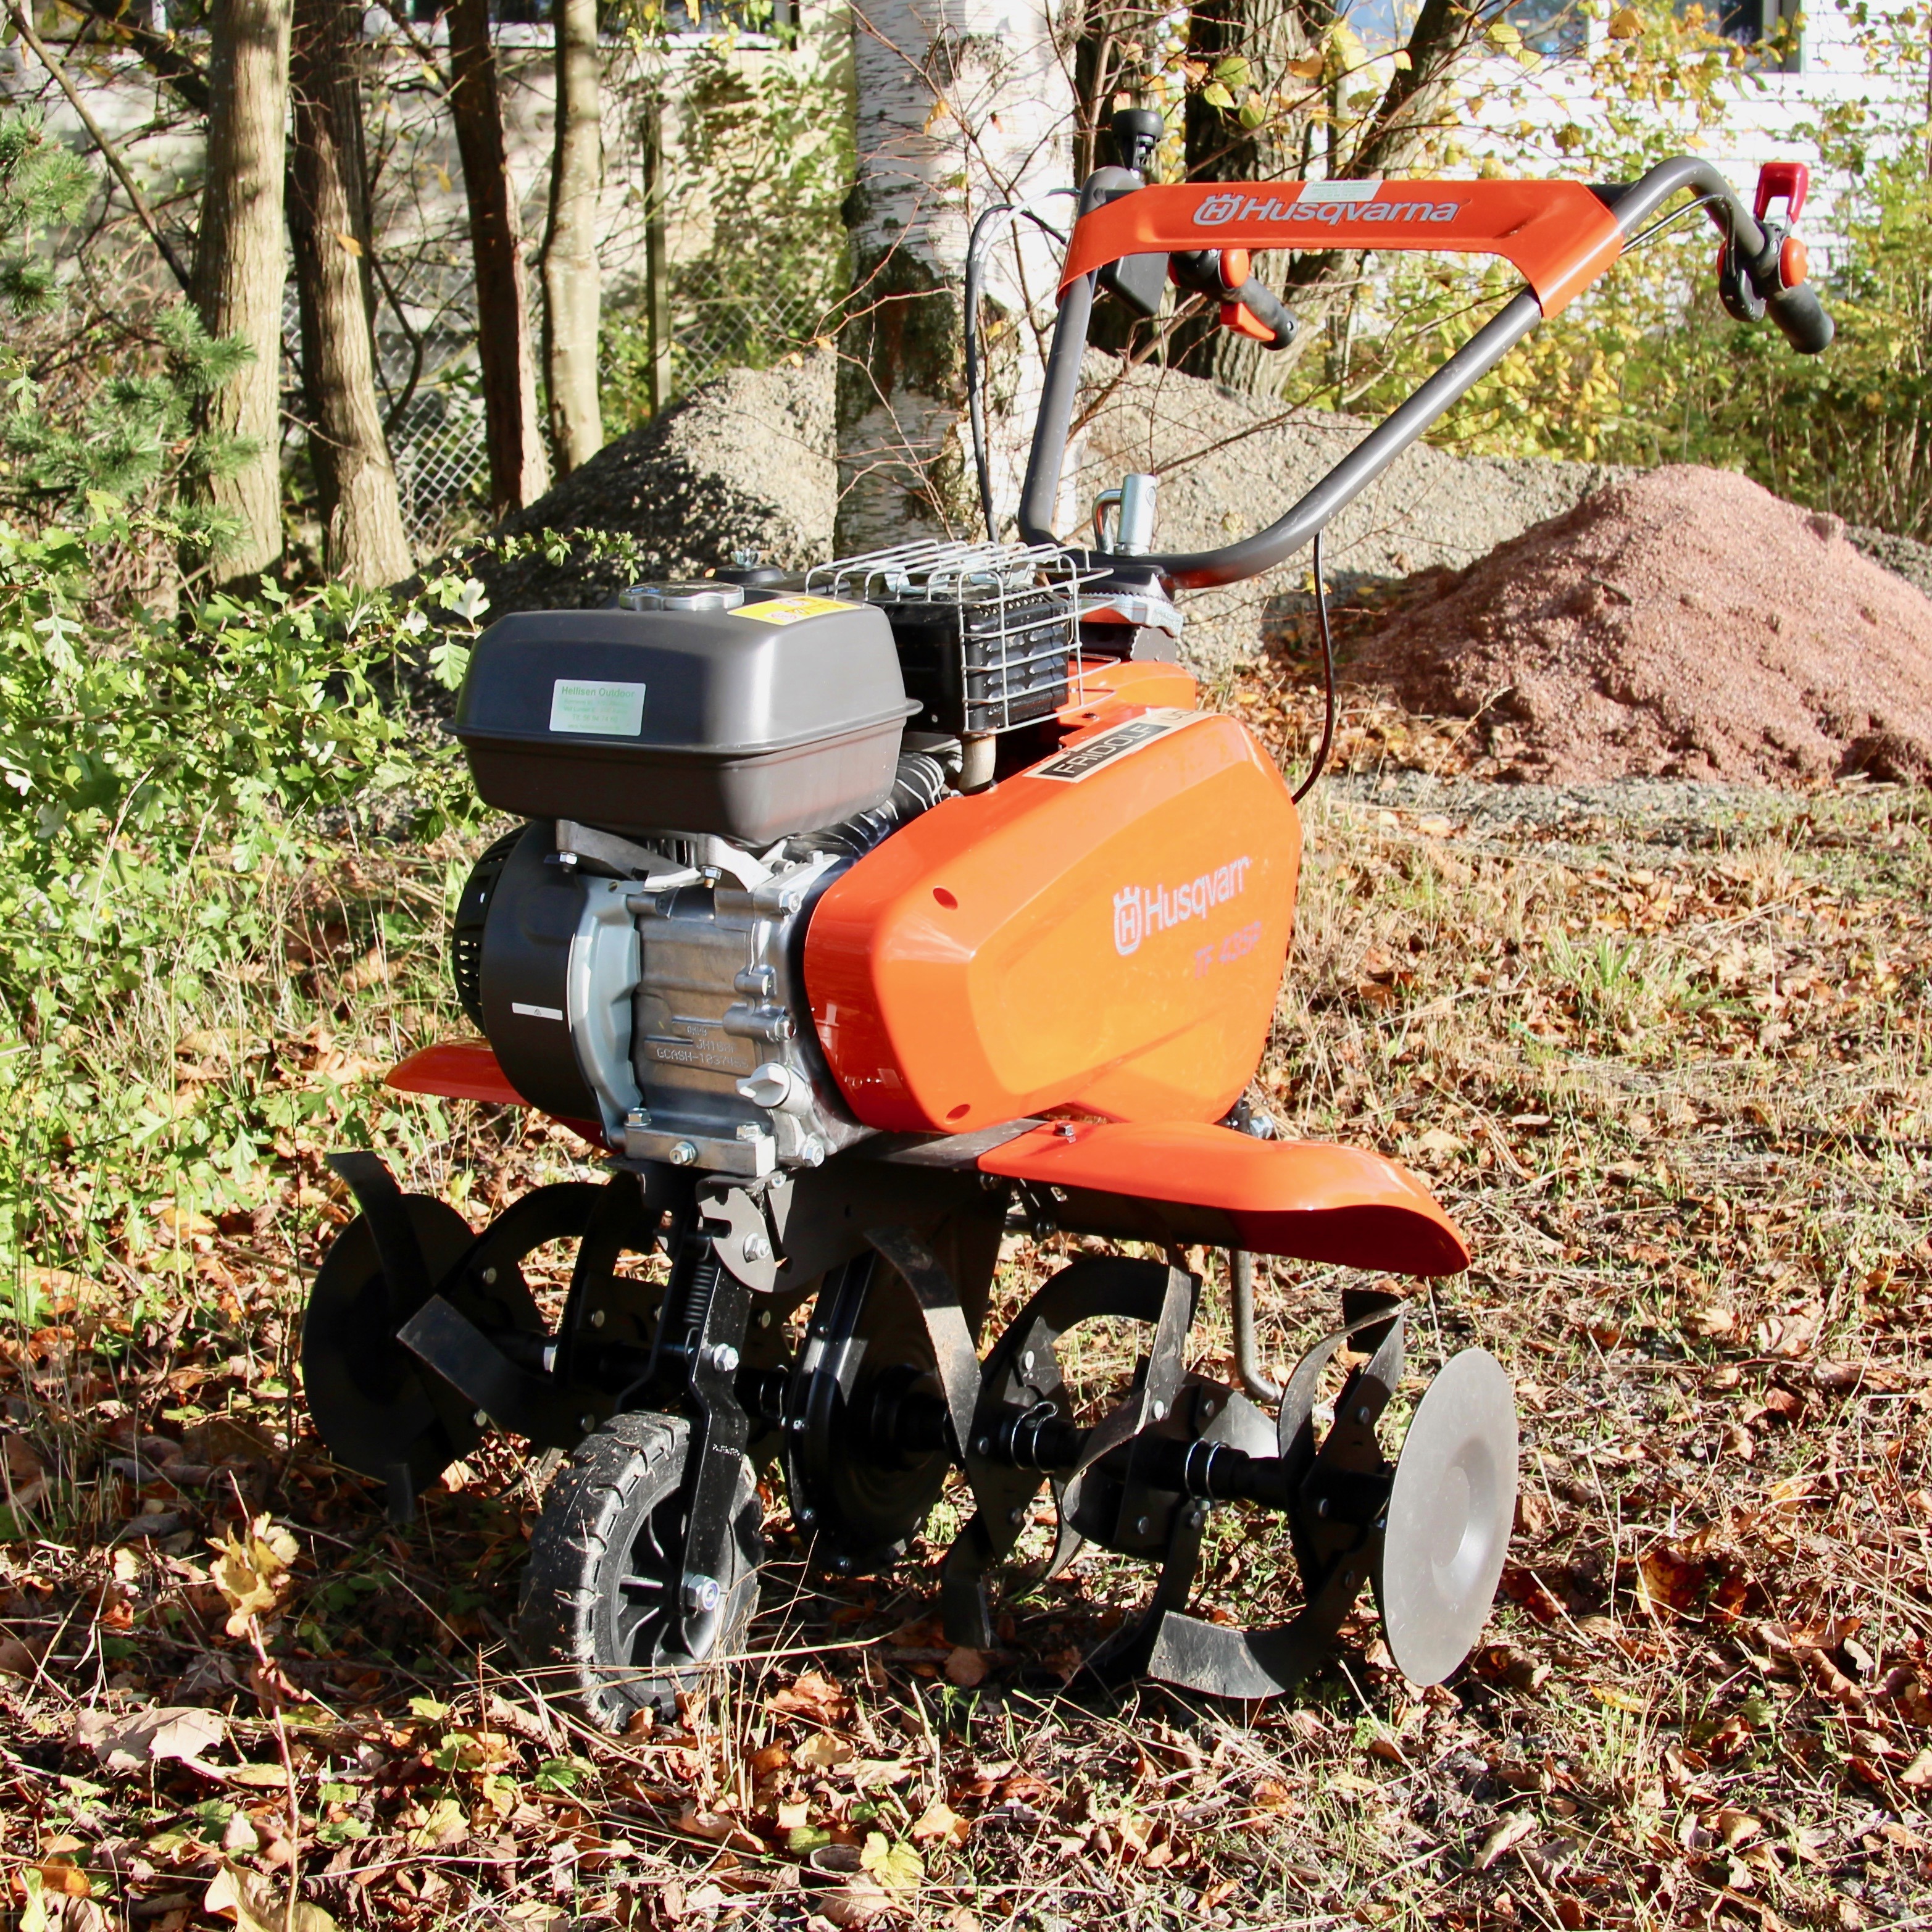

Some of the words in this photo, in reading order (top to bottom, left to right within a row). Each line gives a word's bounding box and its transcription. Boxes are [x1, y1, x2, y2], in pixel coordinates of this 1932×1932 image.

[1237, 197, 1459, 225] Husqvarna
[561, 686, 596, 696] Hellisen
[599, 688, 635, 698] Outdoor
[1053, 725, 1152, 773] FRIDOLF
